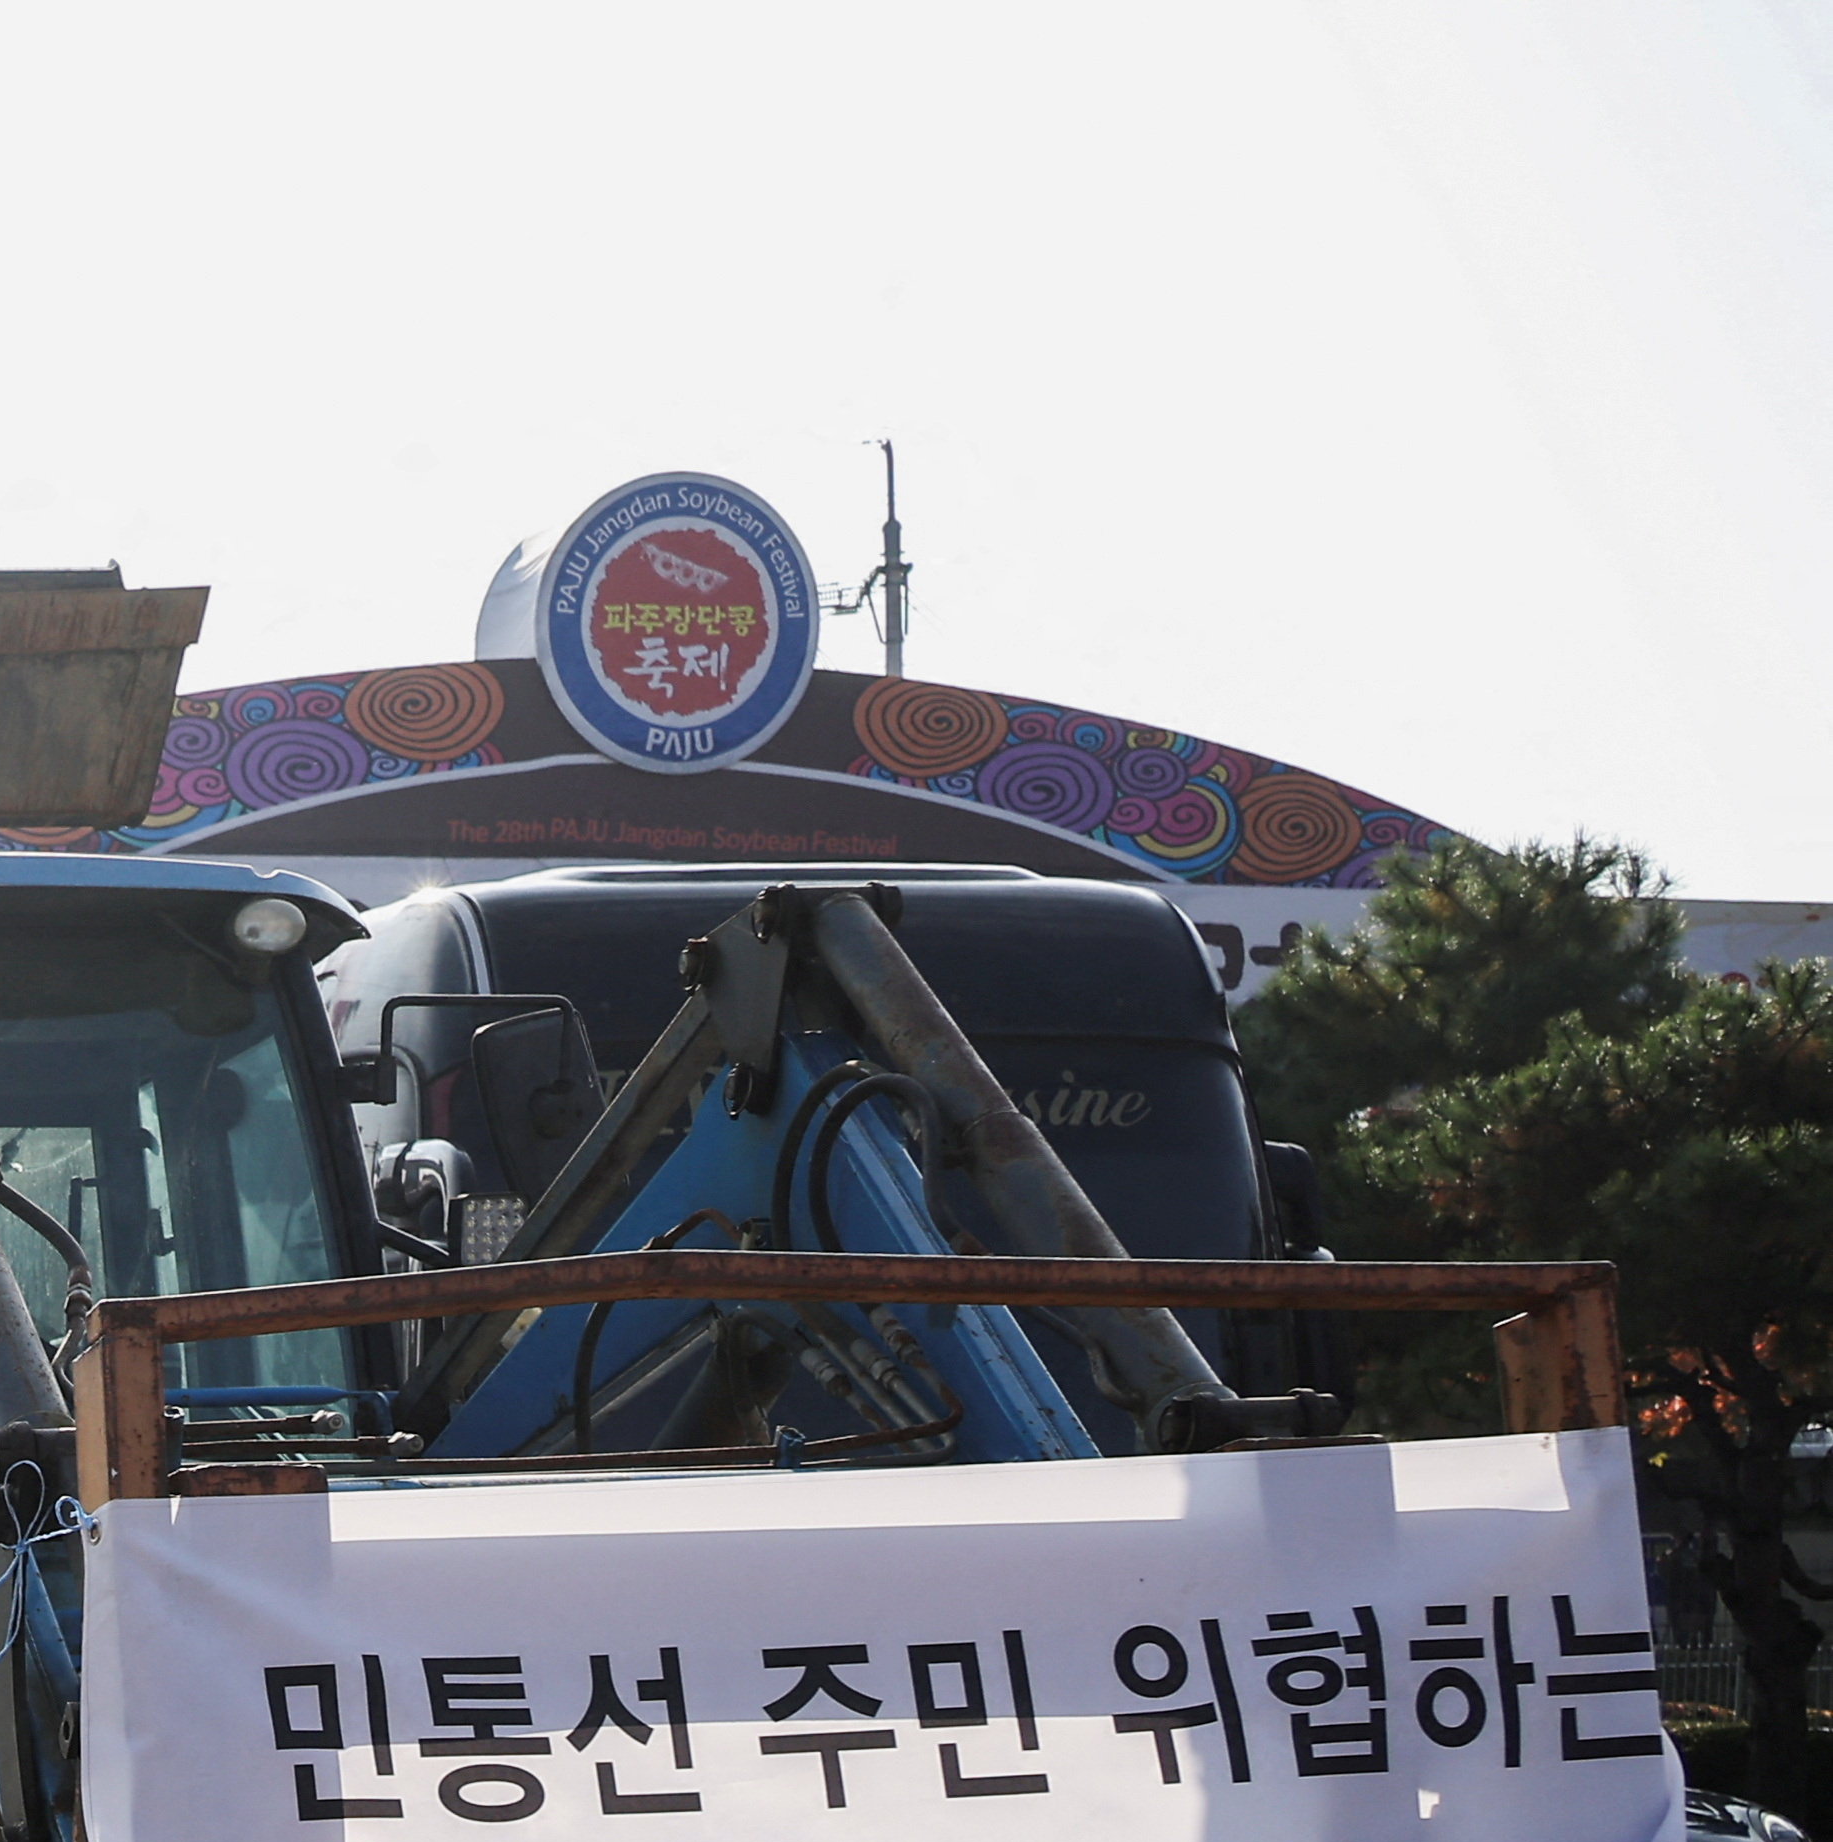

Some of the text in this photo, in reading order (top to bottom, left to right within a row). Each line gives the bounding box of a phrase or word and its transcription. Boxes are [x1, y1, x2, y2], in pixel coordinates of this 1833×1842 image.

[557, 487, 804, 619] PAJU Jangdan Soybean Festival
[603, 603, 756, 637] 파주장단콩
[623, 637, 730, 699] 축제
[645, 726, 715, 760] PAJU
[447, 819, 897, 857] The 28th PAJU Jangdan Soybean Festival
[264, 1594, 1664, 1822] 민통선 주민 위협하는
